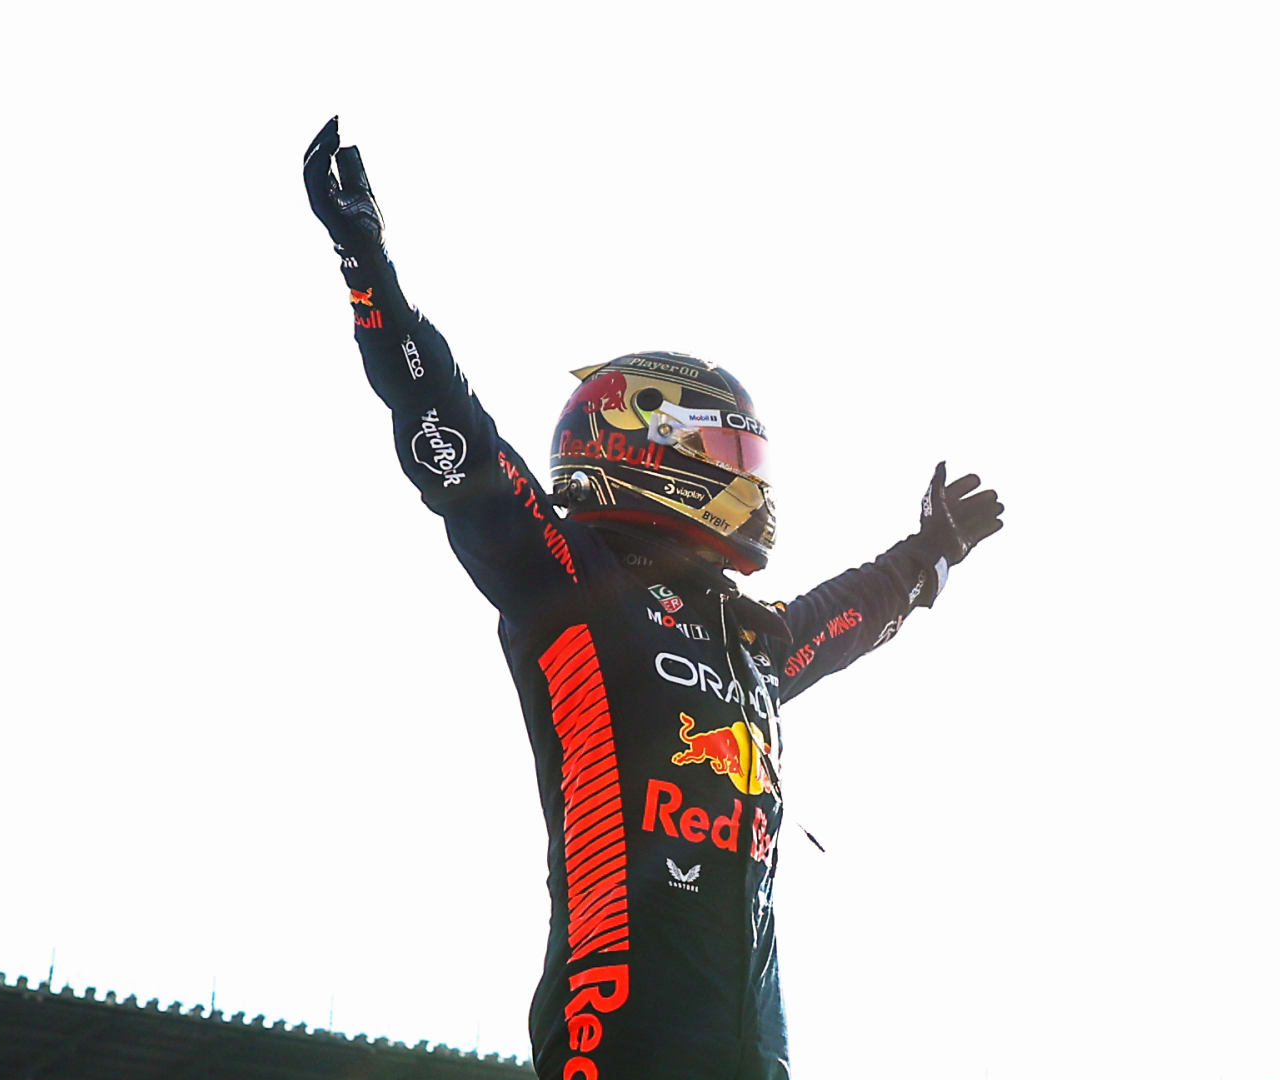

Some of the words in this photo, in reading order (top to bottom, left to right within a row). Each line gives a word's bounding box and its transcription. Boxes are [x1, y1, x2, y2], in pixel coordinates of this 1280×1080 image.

[558, 430, 605, 460] Red
[606, 432, 665, 471] Bull
[641, 778, 743, 853] Red
